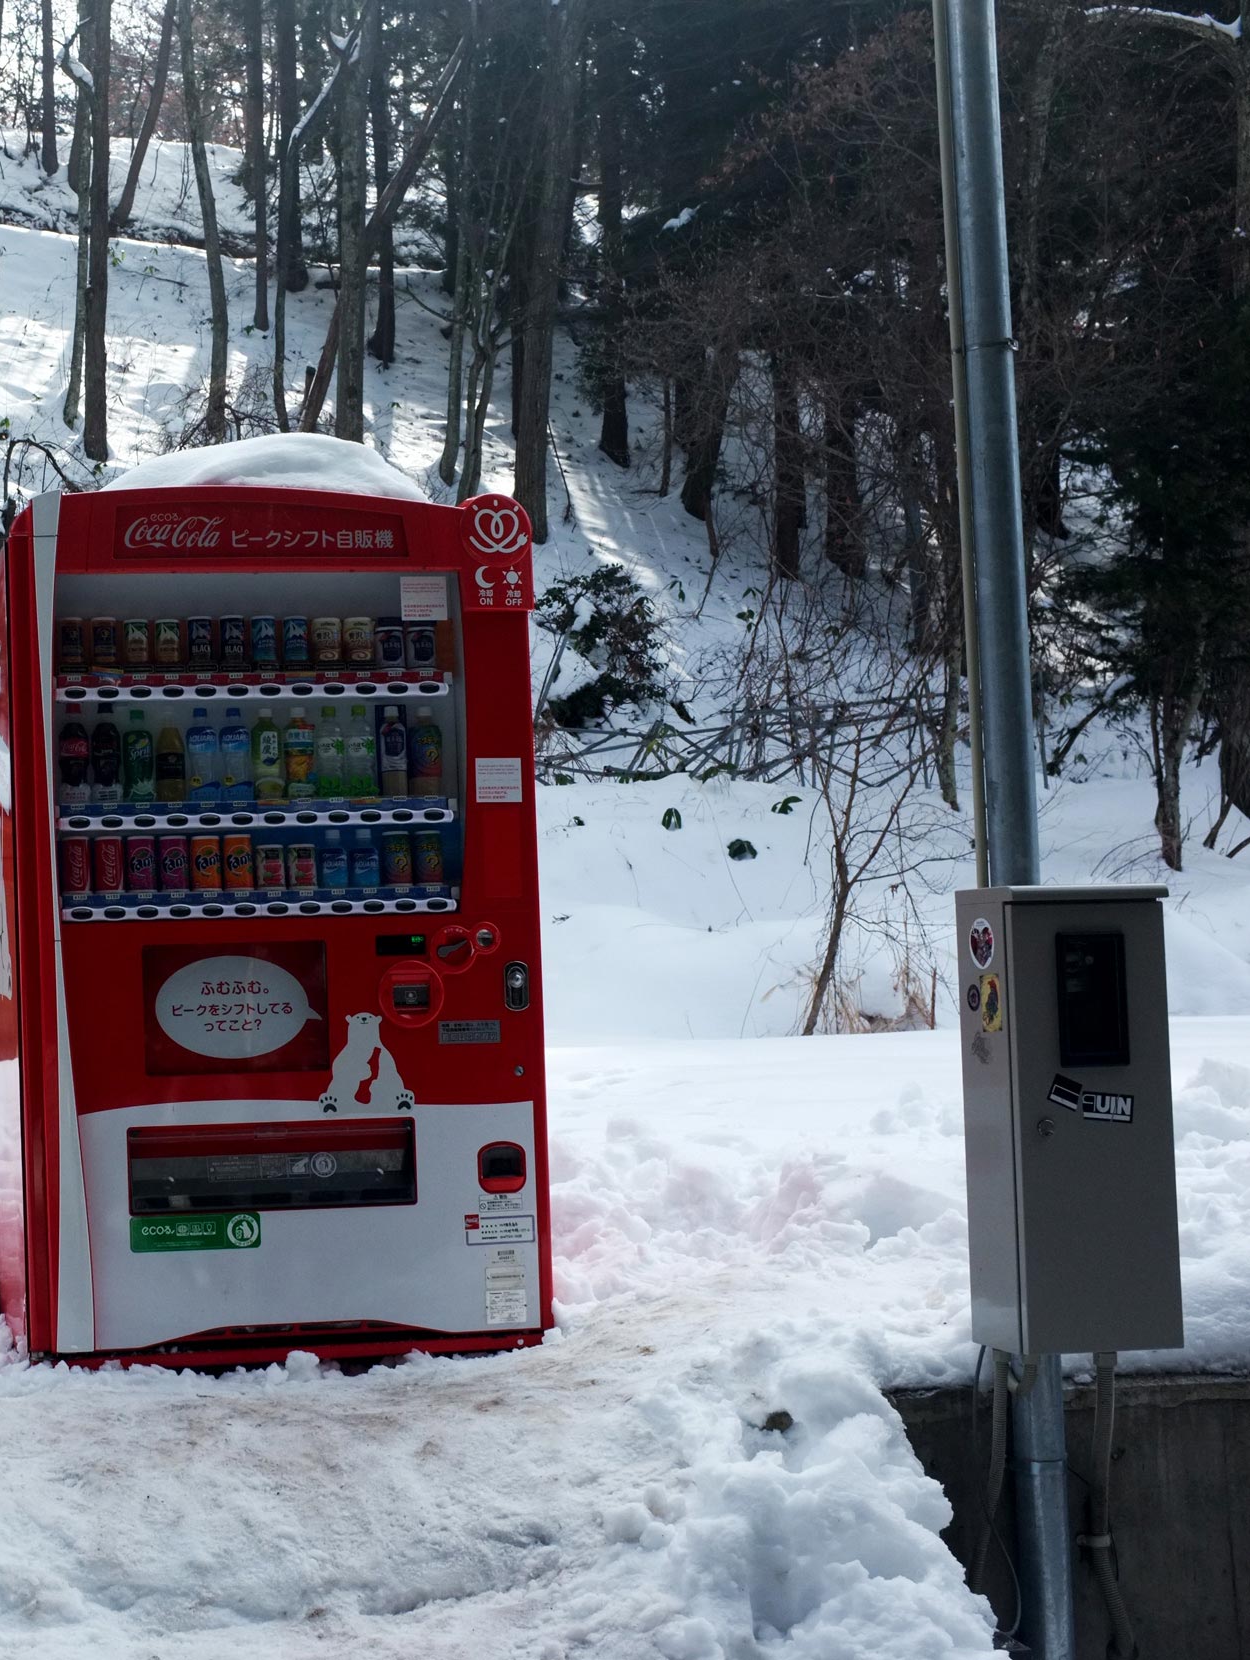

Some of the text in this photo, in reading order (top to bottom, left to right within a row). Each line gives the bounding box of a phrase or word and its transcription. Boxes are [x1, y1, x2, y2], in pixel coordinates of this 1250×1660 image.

[124, 515, 225, 549] Coca-Cola
[231, 529, 394, 549] ピークシフト自販機
[479, 598, 493, 606] ON
[505, 598, 523, 606] OFF
[201, 980, 269, 995] ふむふむ。
[172, 1002, 293, 1017] ピークをシフトしてる
[204, 1019, 262, 1032] ってこと?
